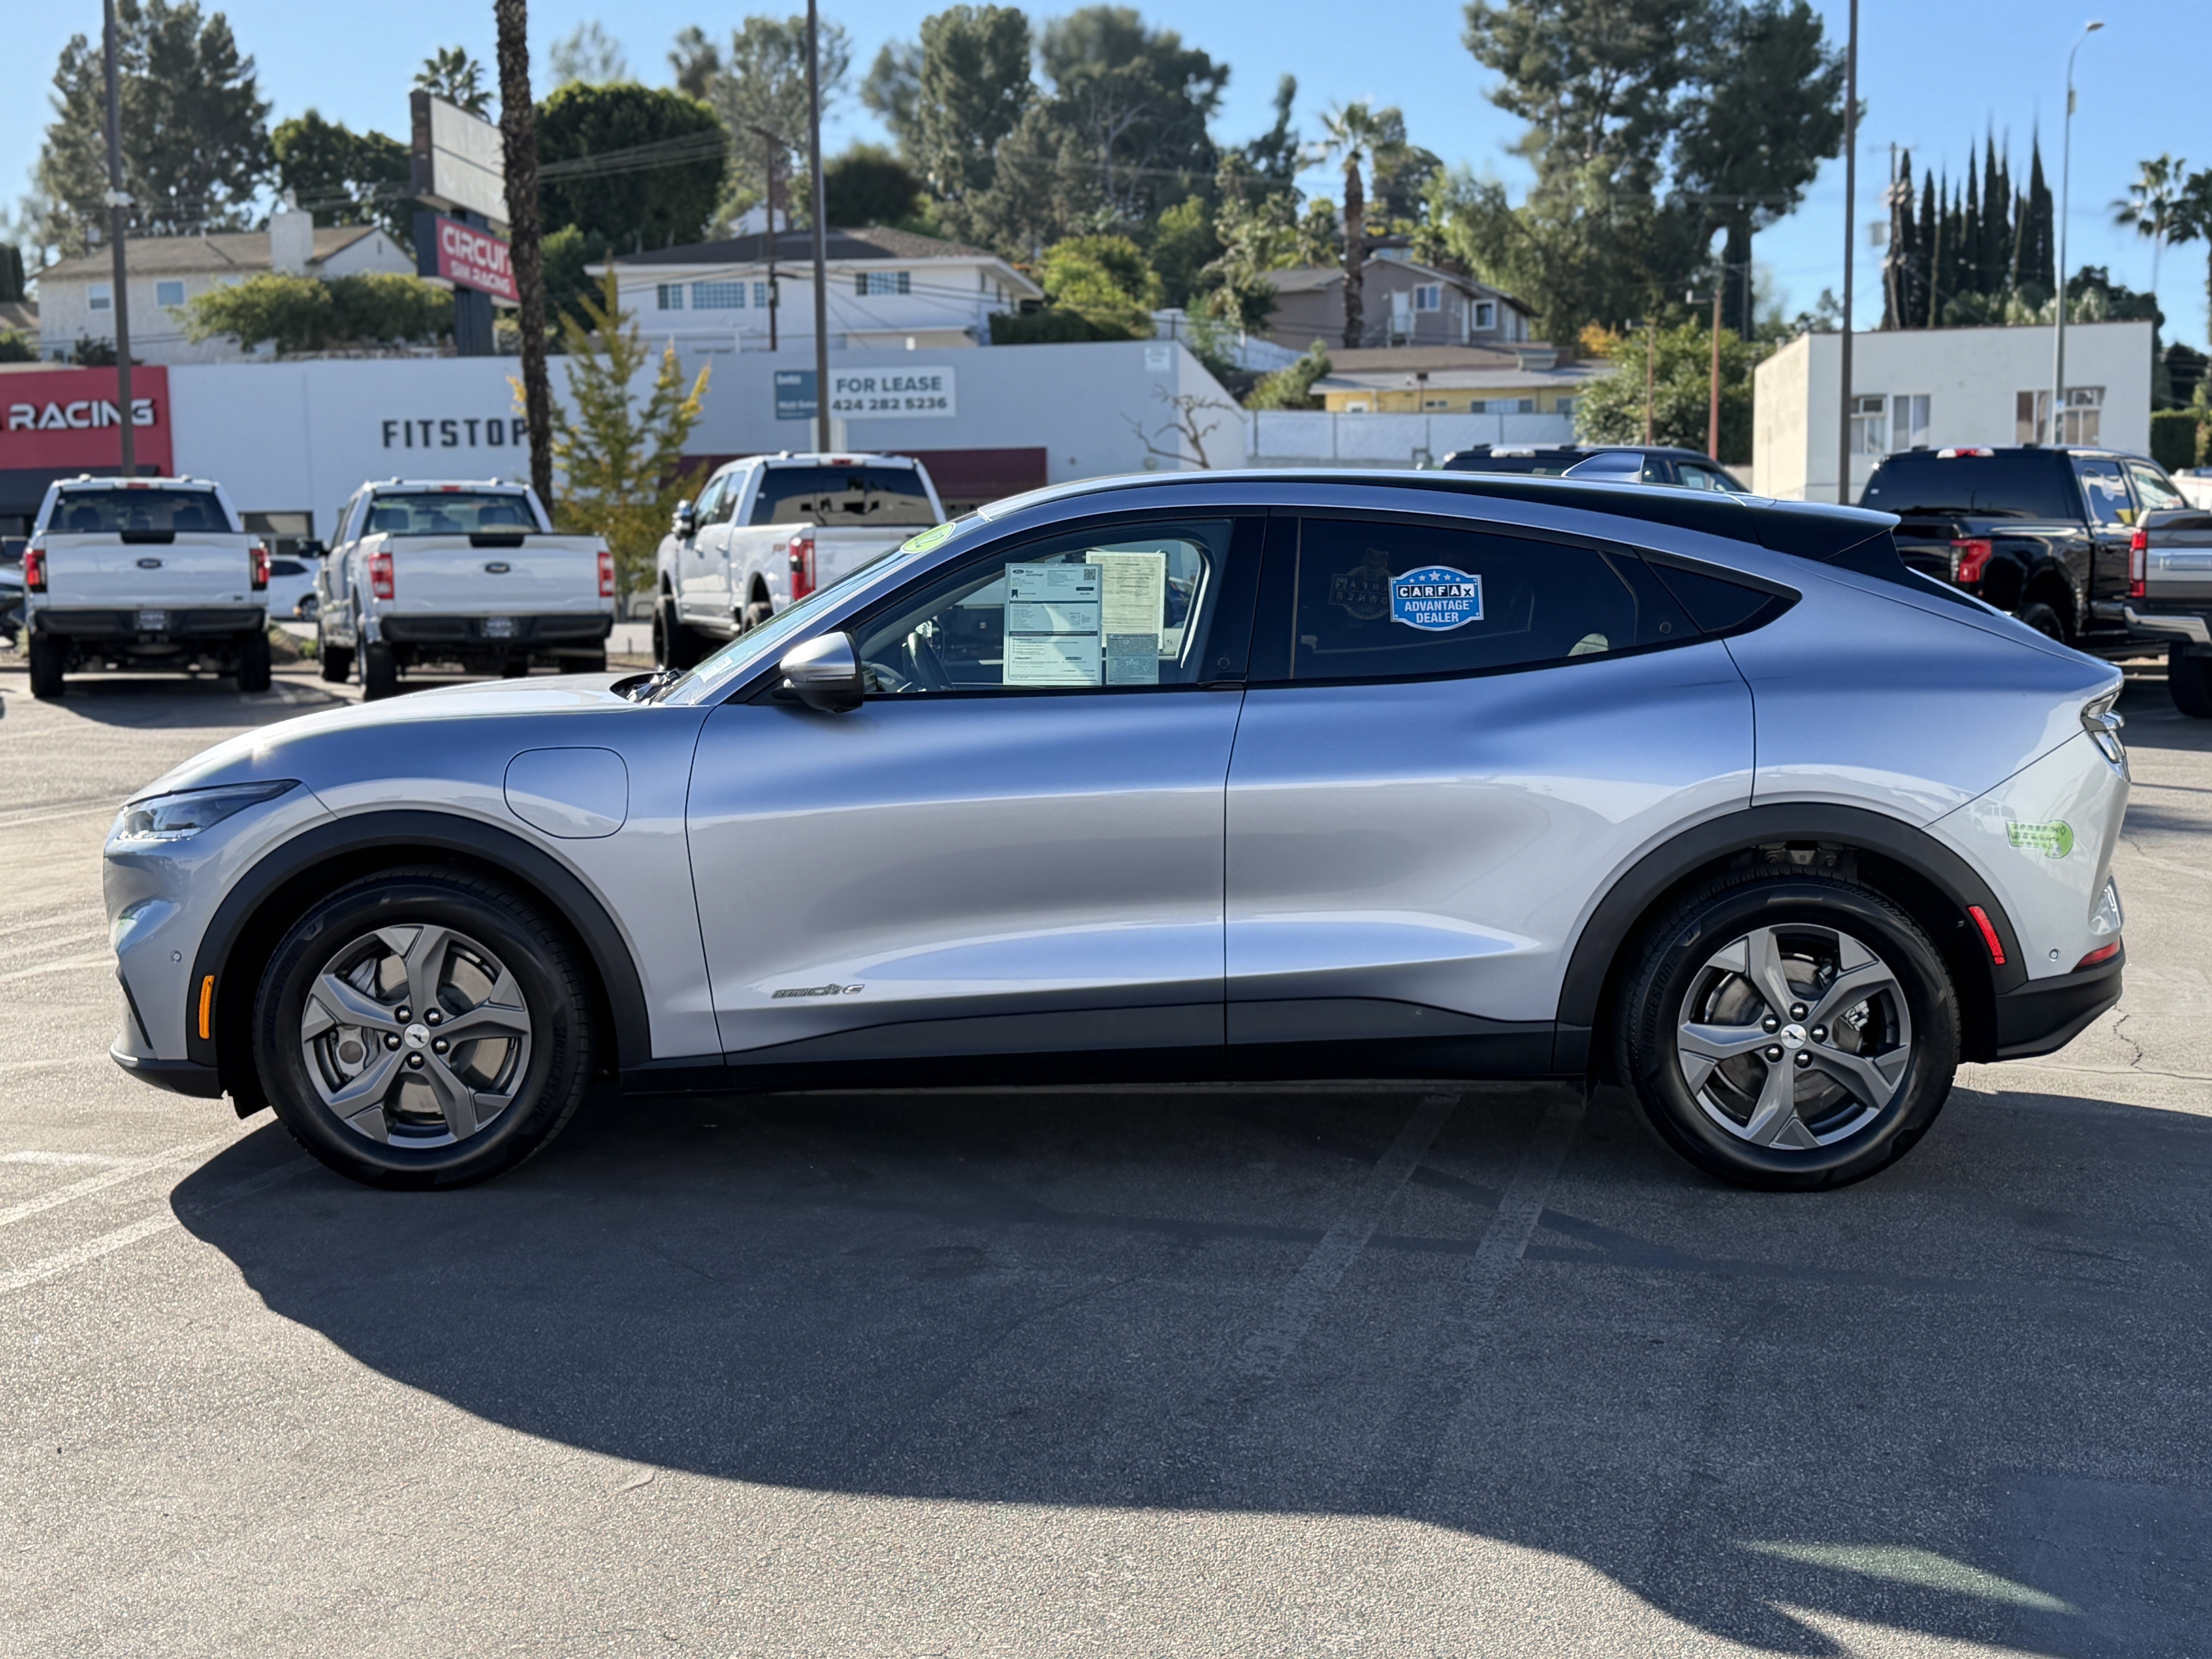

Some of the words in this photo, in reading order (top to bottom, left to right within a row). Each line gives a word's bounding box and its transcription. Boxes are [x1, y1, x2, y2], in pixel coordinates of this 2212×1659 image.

[836, 377, 876, 394] FOR
[881, 376, 942, 392] LEASE
[832, 399, 864, 412] 424
[868, 398, 900, 411] 282
[905, 397, 948, 410] 5236
[9, 398, 155, 431] RACING
[382, 418, 529, 449] FITSTOP
[1400, 586, 1472, 597] CARFAX
[1404, 600, 1470, 611] ADVANTAGE
[1416, 612, 1459, 623] DEALER
